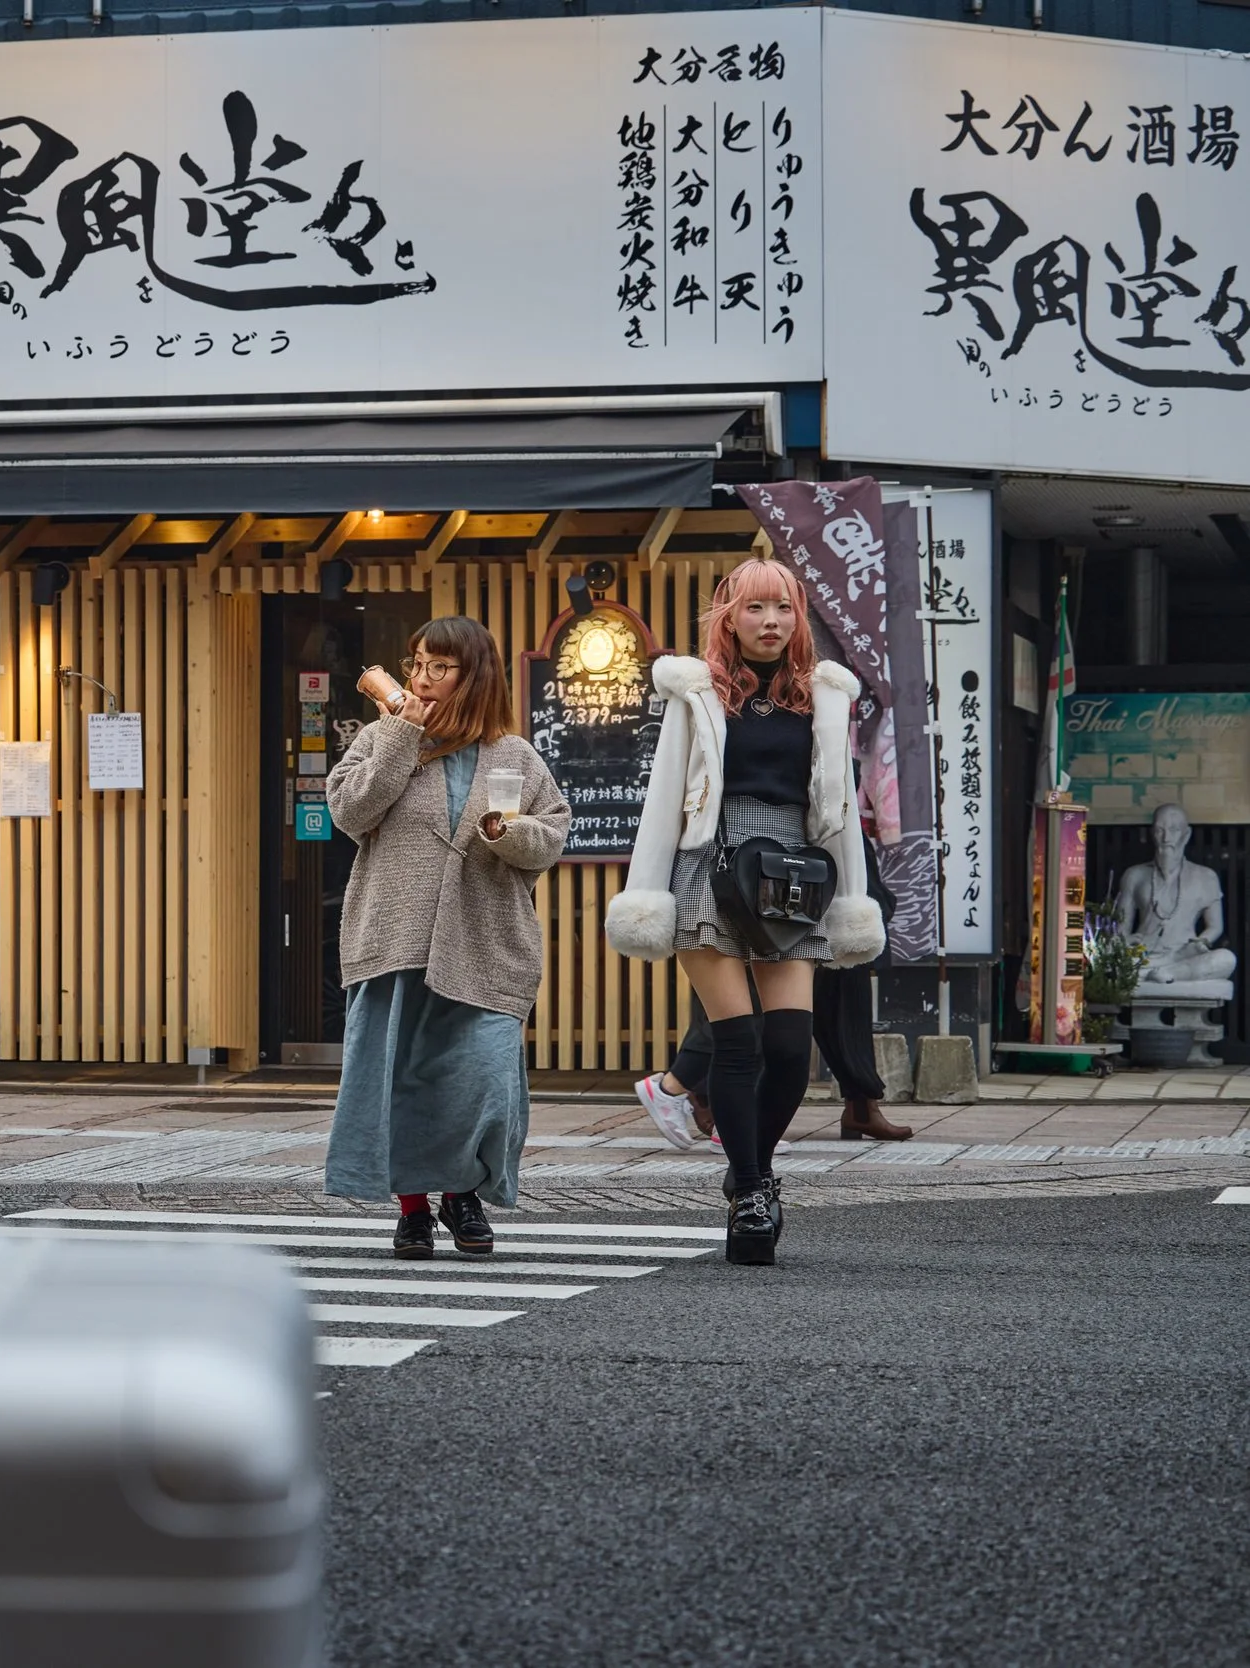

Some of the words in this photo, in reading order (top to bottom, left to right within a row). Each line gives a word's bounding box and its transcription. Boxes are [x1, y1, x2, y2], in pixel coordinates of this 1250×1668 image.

[632, 40, 786, 86] 大分名物
[940, 89, 1241, 172] 大分ん酒場
[616, 110, 657, 349] 地鶏炭火焼き
[670, 114, 710, 315] 大分和牛
[720, 111, 761, 312] とり天
[26, 330, 290, 360] いふうどうどう
[991, 387, 1174, 417] いふうどうどう
[1066, 698, 1128, 733] Thai
[1136, 696, 1242, 737] Massage
